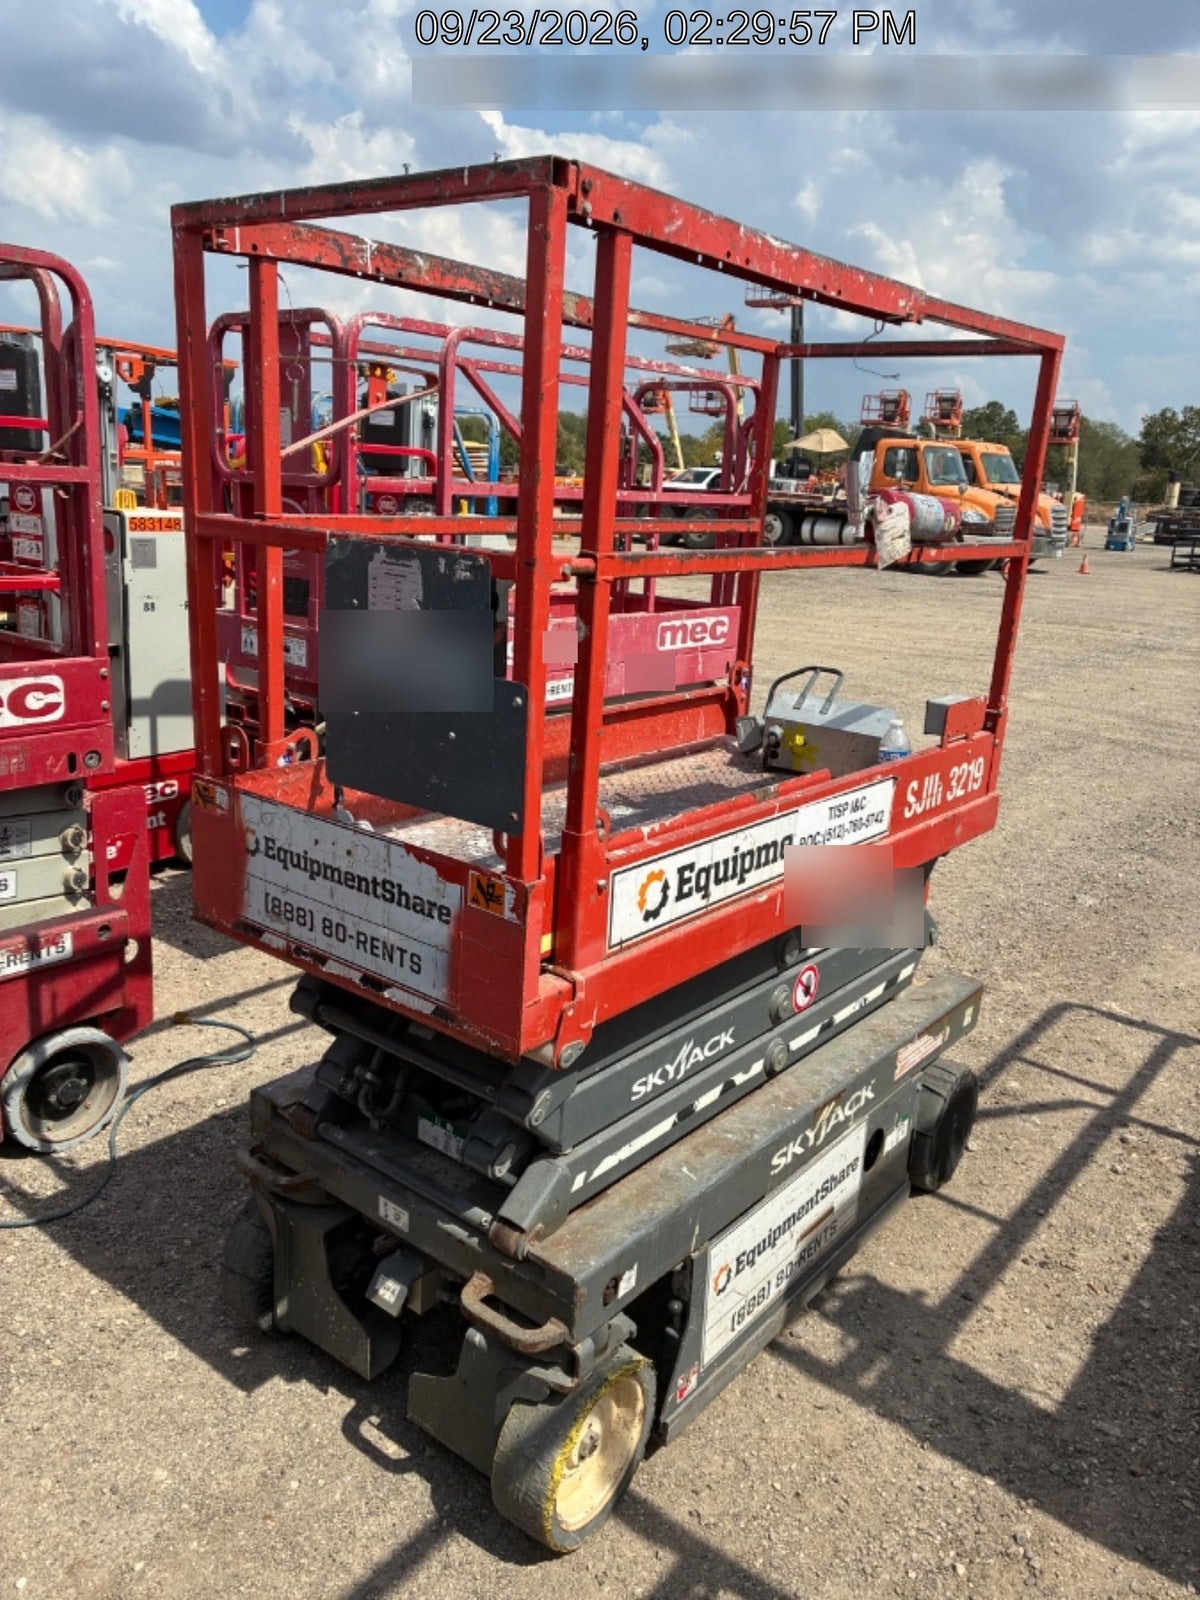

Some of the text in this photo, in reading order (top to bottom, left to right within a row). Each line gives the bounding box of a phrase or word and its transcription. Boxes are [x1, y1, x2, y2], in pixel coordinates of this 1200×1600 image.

[129, 517, 182, 531] 583148
[659, 618, 727, 649] mec
[946, 756, 984, 801] 3219
[264, 836, 451, 925] EquipmentShare
[322, 916, 423, 976] 80-RENTS
[631, 1026, 736, 1101] SKYJACK
[769, 1082, 876, 1176] SKYJACK
[735, 1156, 860, 1276] EquipmentShare
